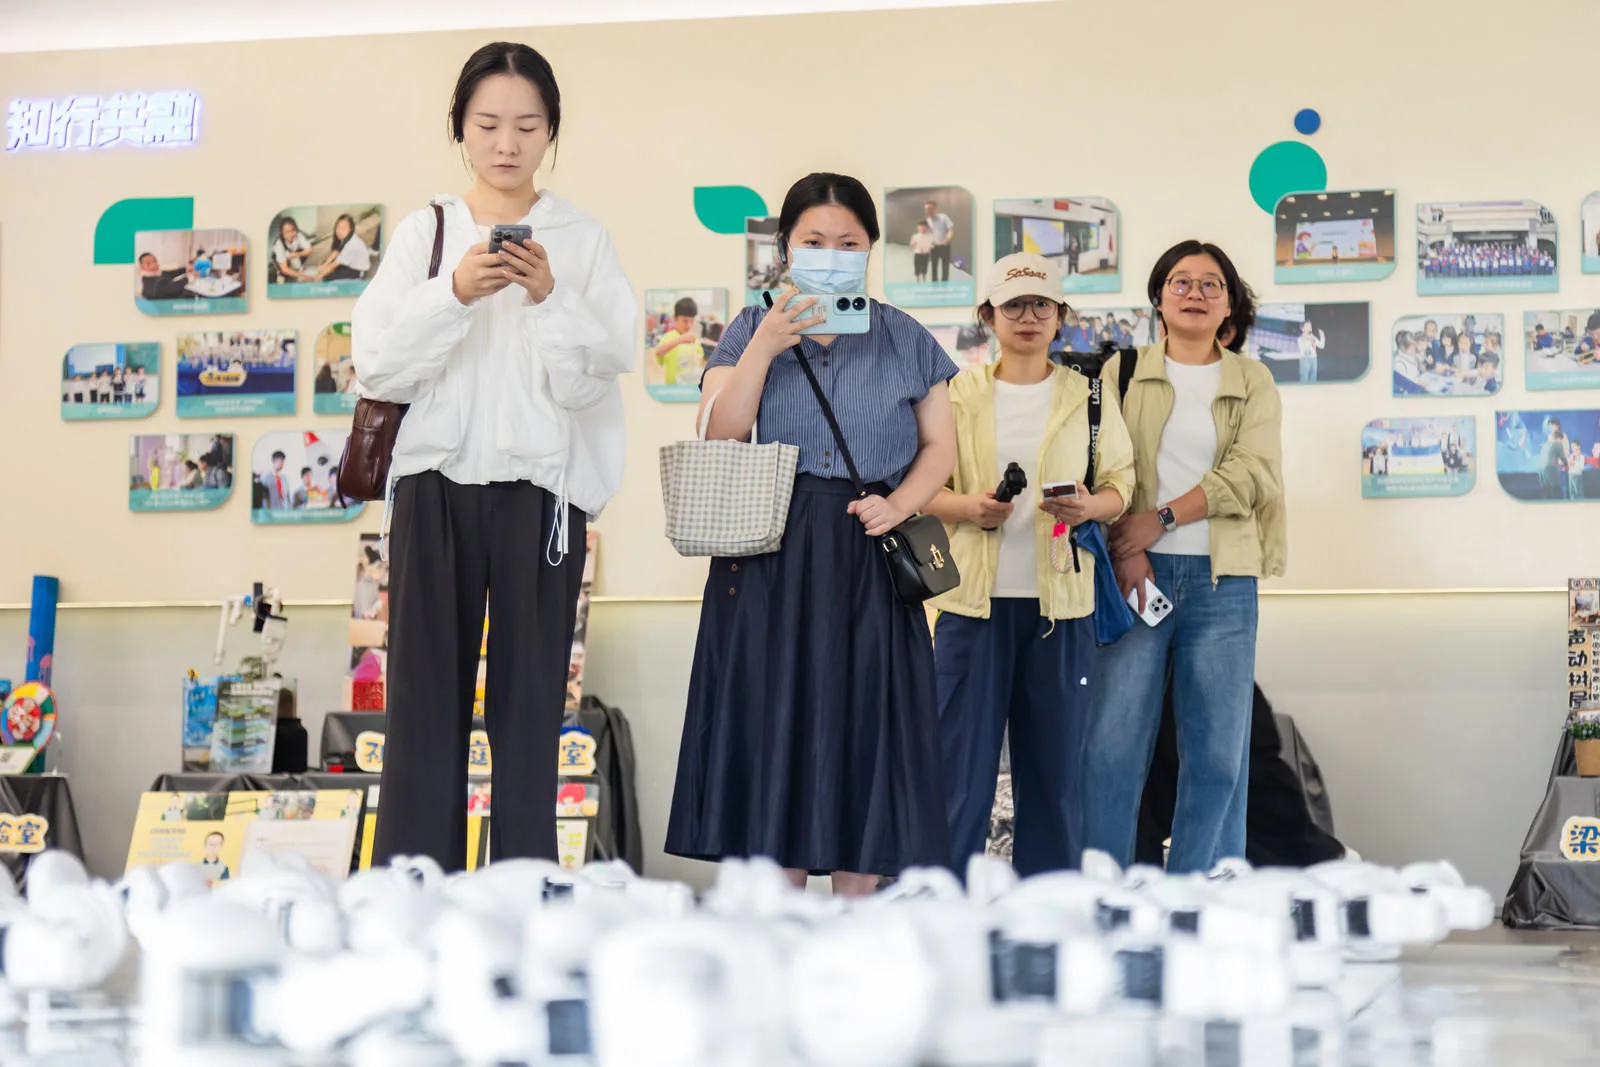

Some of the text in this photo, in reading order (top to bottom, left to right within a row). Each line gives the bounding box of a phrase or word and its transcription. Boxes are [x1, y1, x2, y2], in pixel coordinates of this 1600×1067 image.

[5, 92, 197, 151] 知行共融
[1567, 628, 1588, 709] 声动树屋
[560, 741, 587, 766] 室
[1568, 824, 1600, 855] 梁
